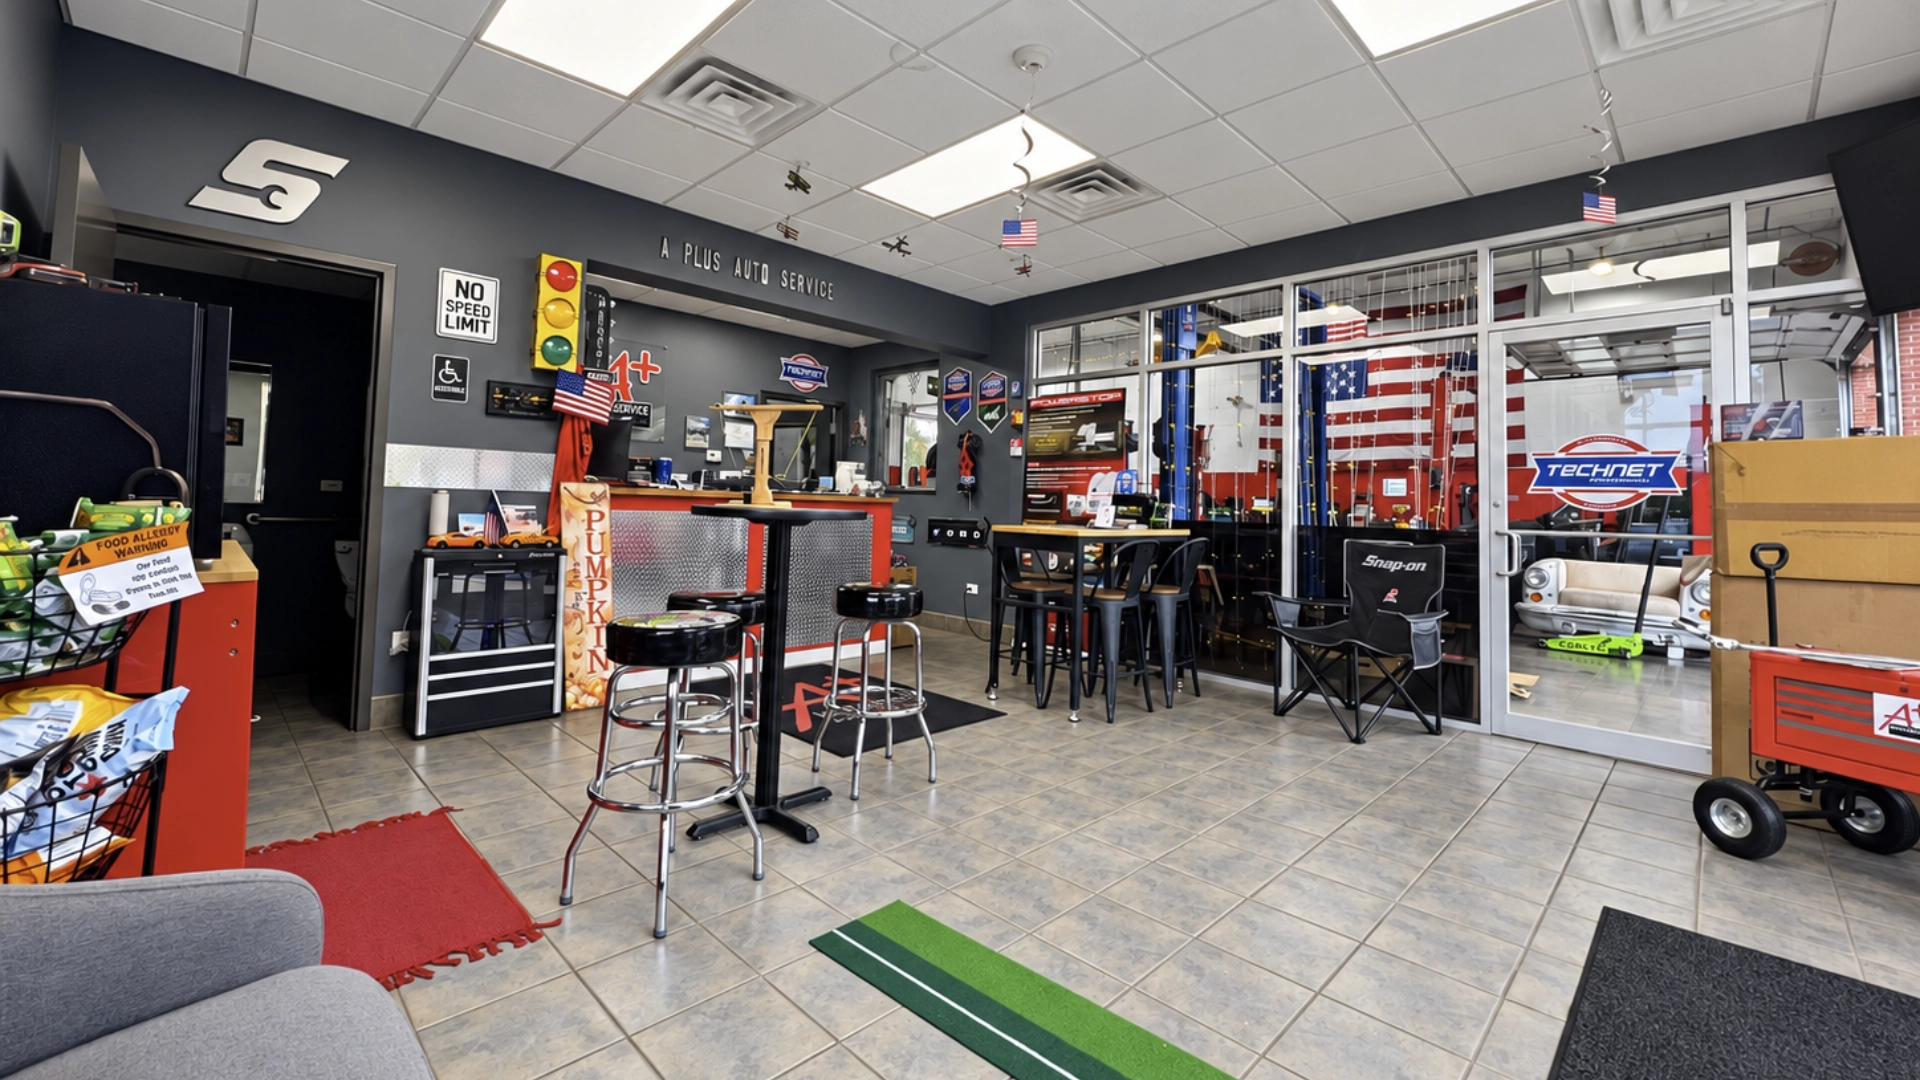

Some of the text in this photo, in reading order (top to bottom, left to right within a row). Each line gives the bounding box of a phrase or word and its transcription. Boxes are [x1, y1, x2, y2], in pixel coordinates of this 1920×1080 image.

[661, 236, 834, 301] A PLUS AUTO SERVICE
[455, 279, 485, 302] NO
[445, 299, 491, 319] SPEED
[445, 314, 491, 335] LIMIT
[96, 535, 129, 552] FOOD
[1361, 554, 1428, 573] Snap-on
[585, 509, 609, 675] PUMPKIN
